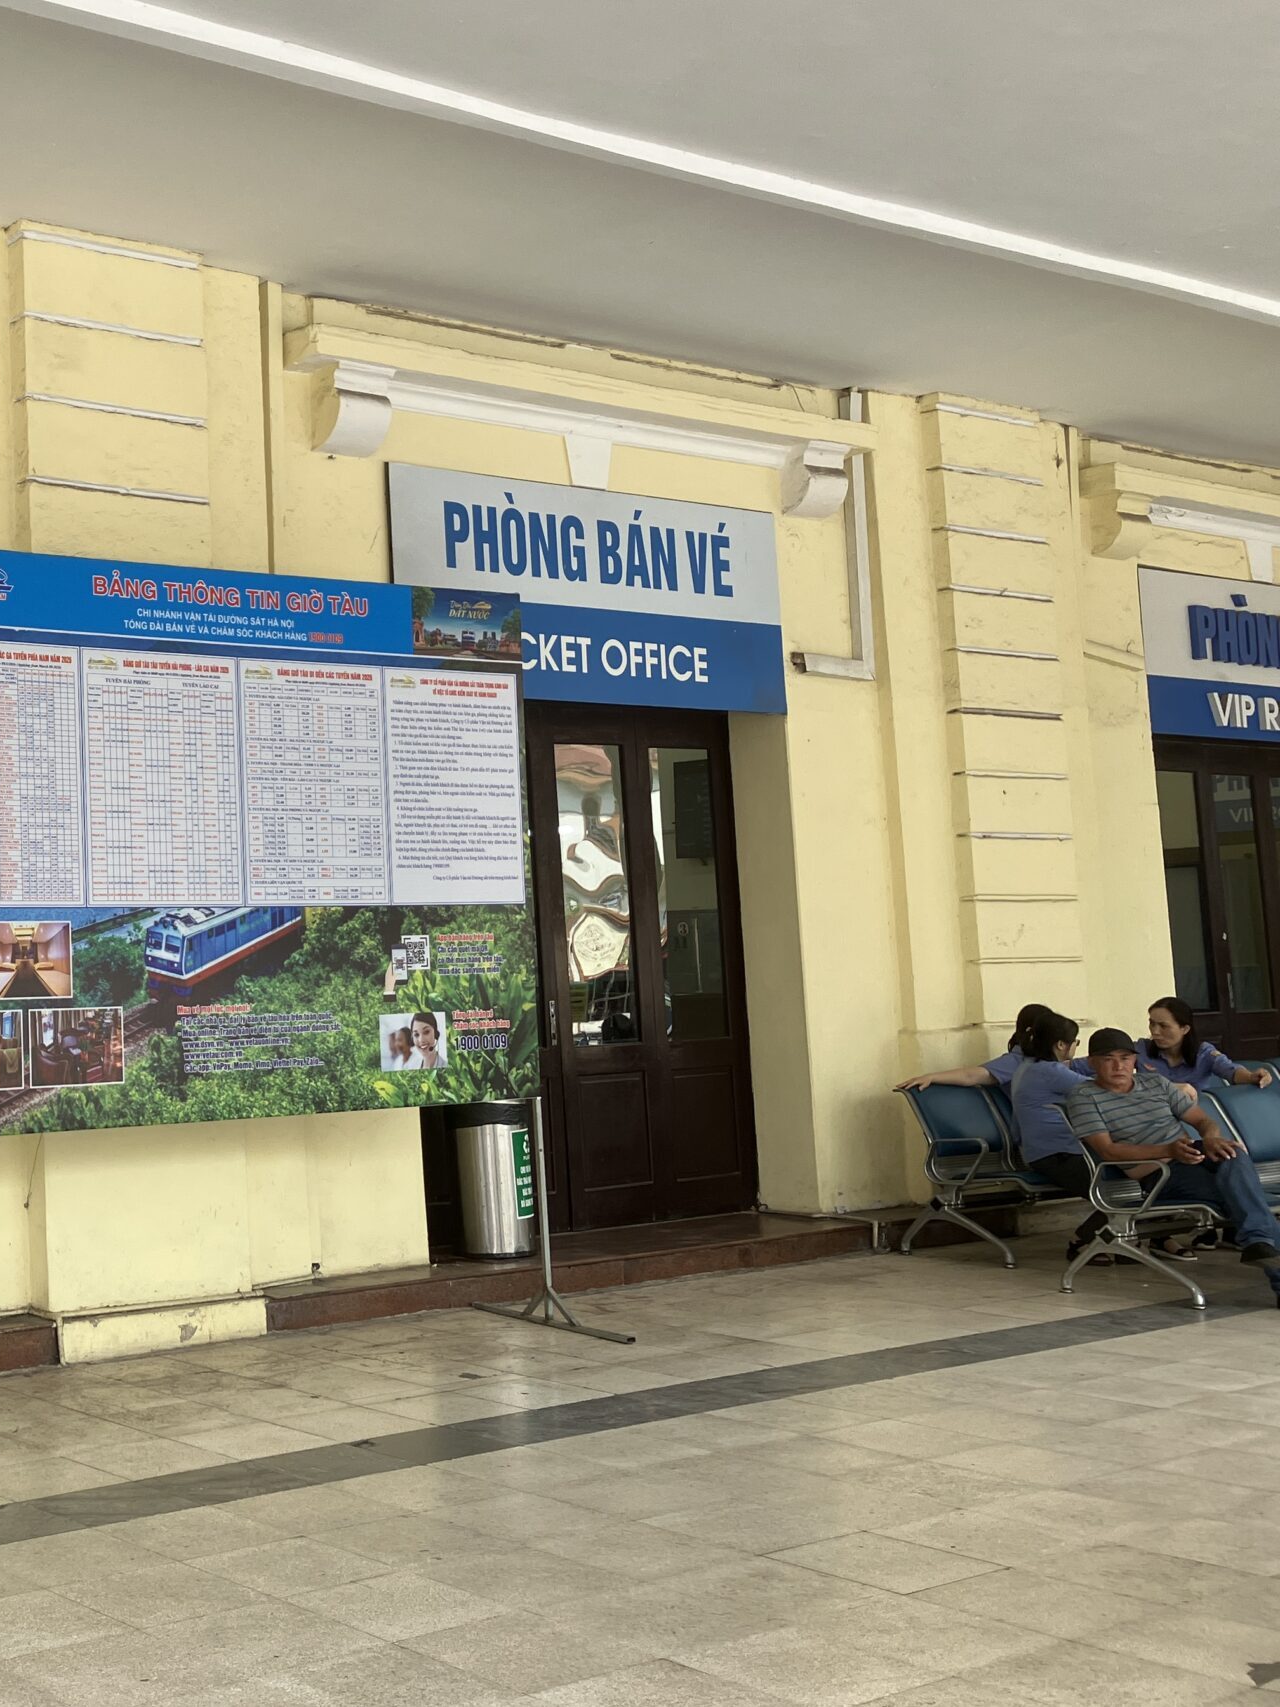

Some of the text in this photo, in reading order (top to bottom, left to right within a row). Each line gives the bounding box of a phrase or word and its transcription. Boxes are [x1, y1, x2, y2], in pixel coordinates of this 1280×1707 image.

[443, 491, 734, 598] PHÒNG BÁN VÉ
[92, 570, 368, 617] BẢNG THÔNG TIN GIỜ TÀU
[124, 618, 148, 631] TỔNG
[149, 620, 164, 632] ĐÀI
[165, 621, 184, 633] BÁN
[185, 622, 196, 634] VÉ
[197, 623, 209, 635] VÀ
[210, 624, 234, 637] CHĂM
[236, 627, 254, 638] SÓC
[255, 629, 283, 640] KHÁCH
[284, 631, 308, 642] HÀNG
[137, 608, 295, 630] CHI NHÁNH VẬN TẢI ĐƯỜNG SẮT HÀ NỘI
[1188, 593, 1280, 669] PHÒN
[521, 631, 709, 684] CKET OFFICE
[1207, 692, 1255, 728] VIP
[182, 1028, 196, 1038] Mua
[454, 1034, 508, 1051] 1900 0109
